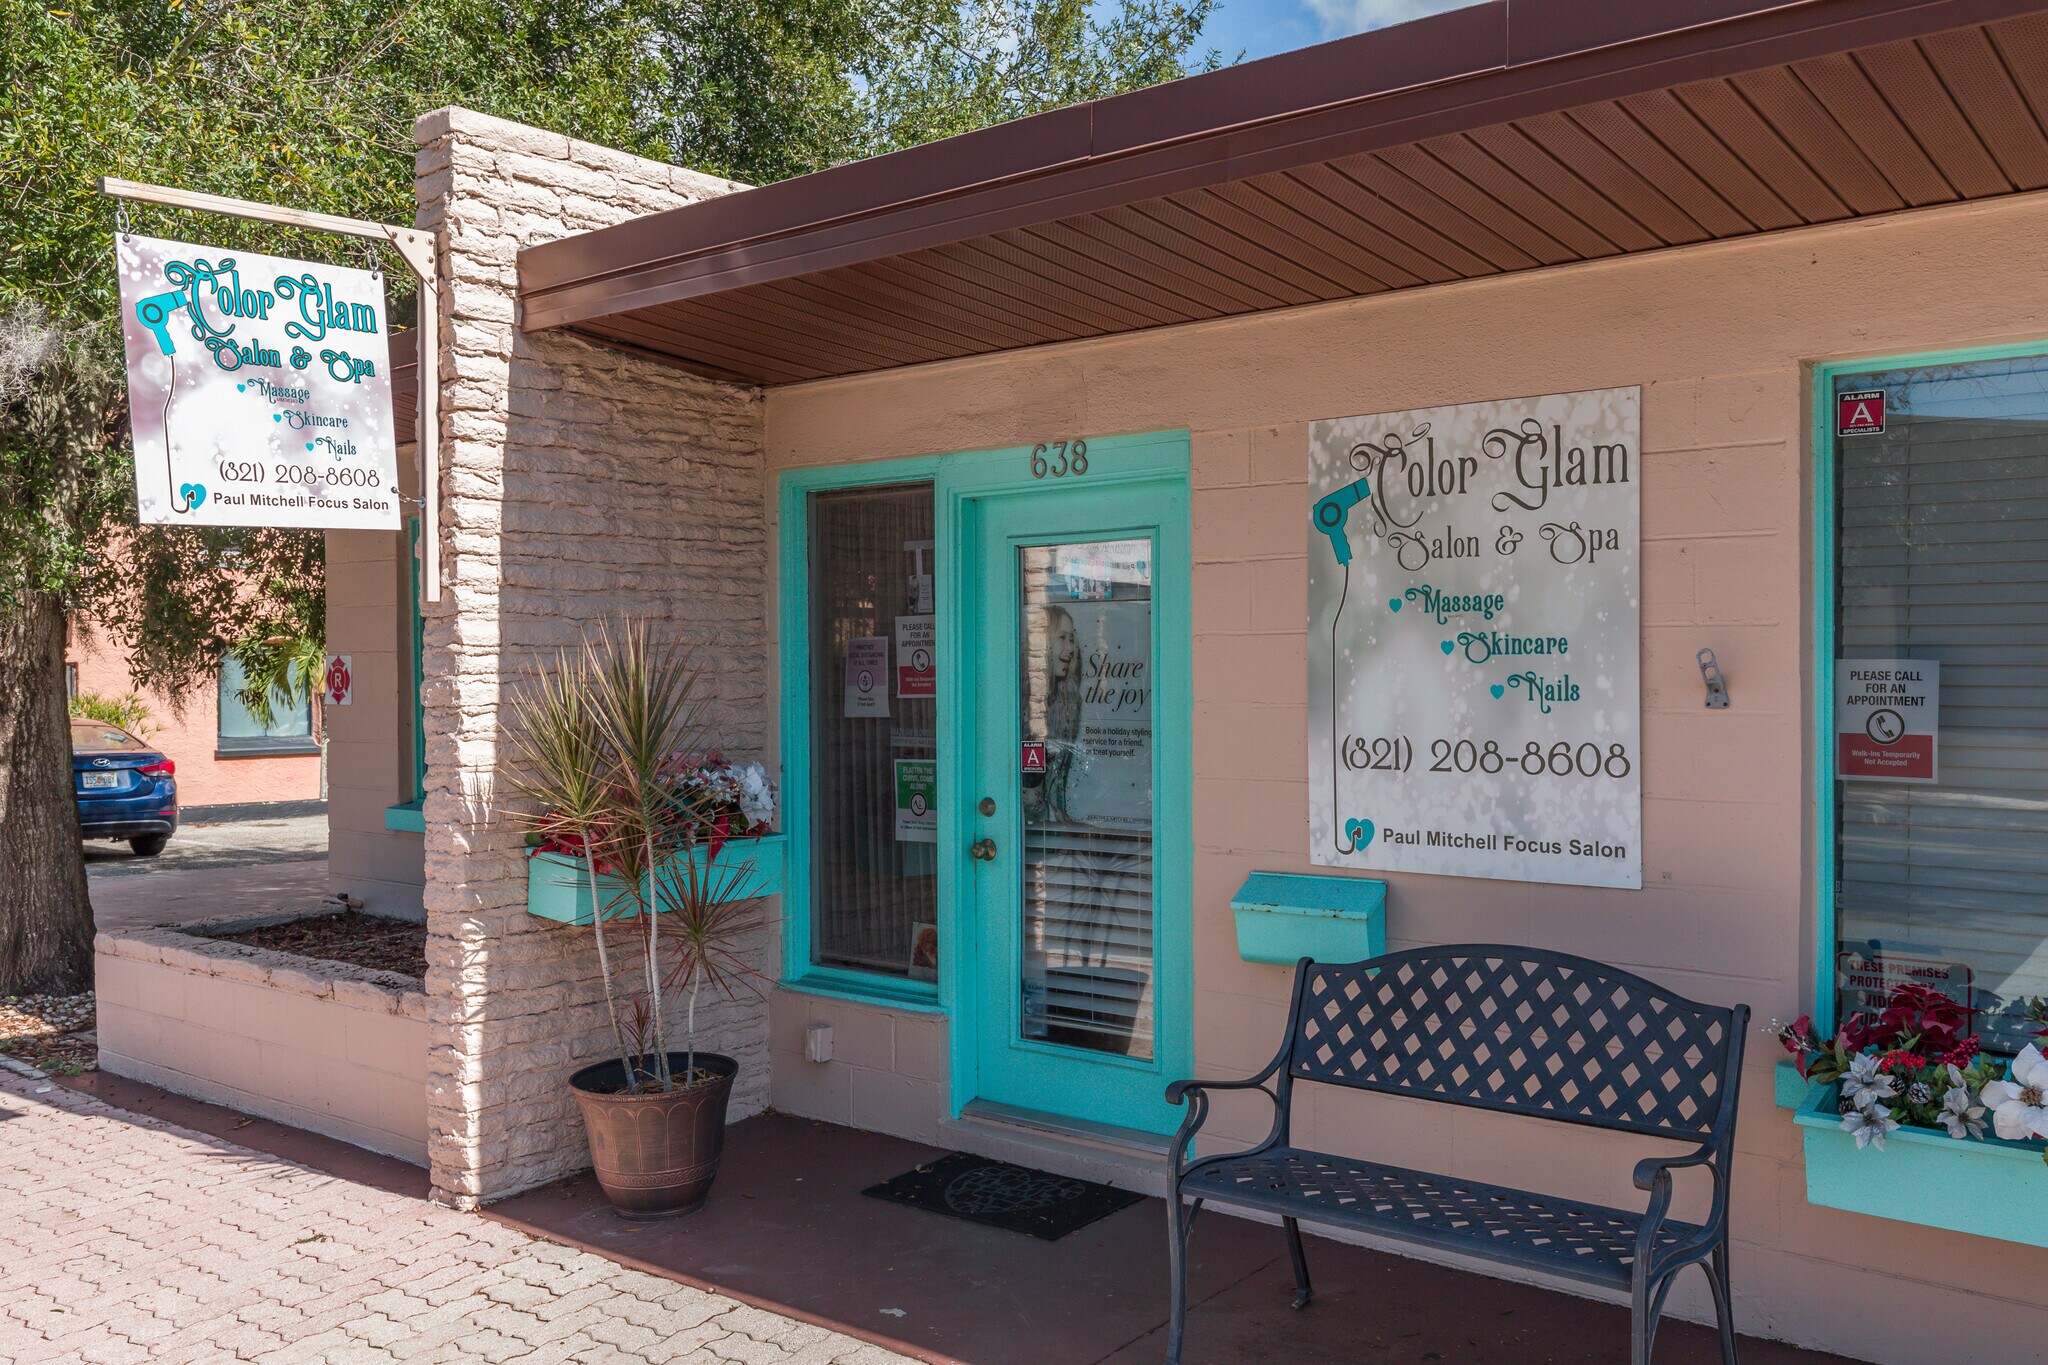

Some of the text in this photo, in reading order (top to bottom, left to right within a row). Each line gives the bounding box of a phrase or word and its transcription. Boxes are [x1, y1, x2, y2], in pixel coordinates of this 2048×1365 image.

[165, 258, 378, 341] Color Glam
[205, 337, 375, 383] Salon & Spa
[247, 378, 310, 404] Massage
[1844, 393, 1880, 401] ALARM
[283, 409, 348, 430] Skincare
[1850, 402, 1874, 424] A
[315, 436, 357, 461] Nails
[1031, 440, 1088, 479] 638
[275, 464, 380, 488] 208-8608
[1350, 417, 1630, 538] Color Glam
[213, 492, 389, 510] Paul Mitchell Focus Salon
[1387, 521, 1620, 571] Salon & Spa
[1405, 584, 1504, 625] Massage
[902, 623, 922, 631] PLEASE
[1457, 631, 1569, 664] Skincare
[1086, 653, 1144, 678] Share
[1850, 670, 1923, 682] PLEASE CALL
[334, 673, 342, 688] R
[1507, 671, 1580, 714] Nails
[1866, 684, 1906, 693] FOR AN
[1085, 679, 1152, 713] the joy
[1846, 696, 1926, 706] APPOINTMENT
[1086, 726, 1101, 734] Book
[1108, 728, 1130, 737] holiday
[1124, 739, 1144, 748] friend,
[1028, 749, 1039, 764] A
[1429, 738, 1631, 778] 208-8608
[1882, 751, 1920, 759] Temporarily
[1383, 828, 1626, 859] Paul Mitchell Focus Salon
[1850, 960, 1950, 980] THESE PREMISES
